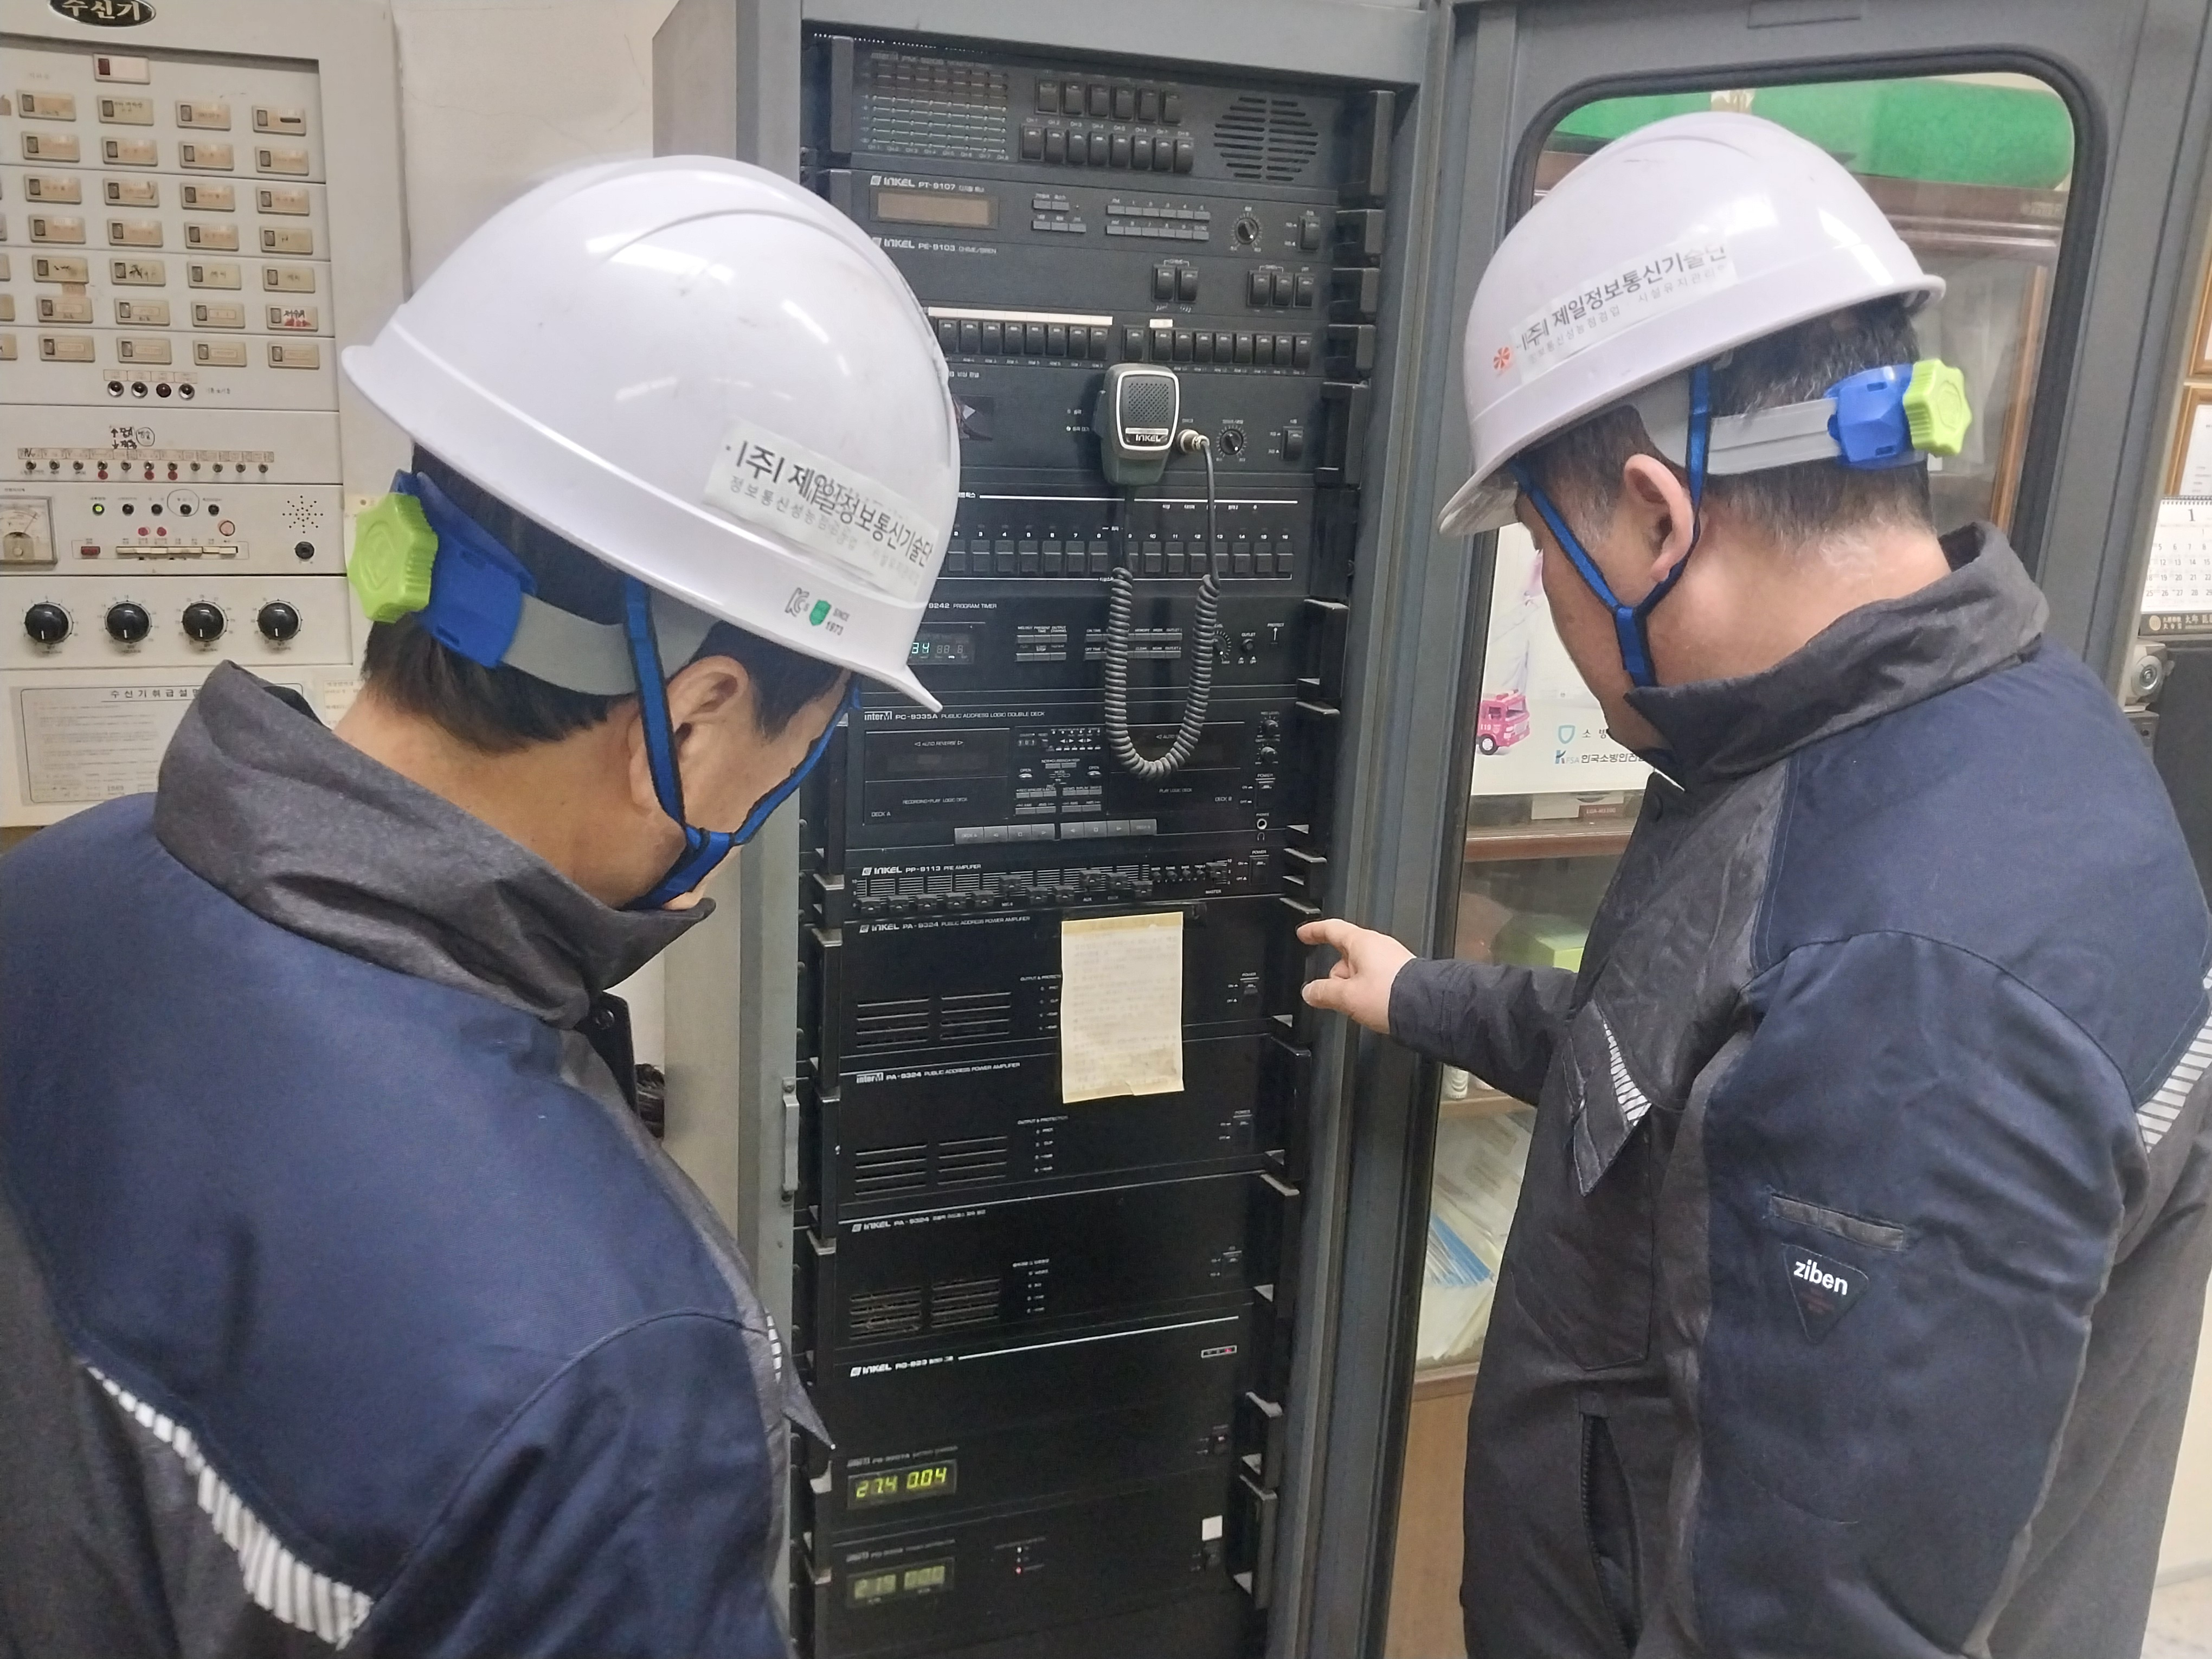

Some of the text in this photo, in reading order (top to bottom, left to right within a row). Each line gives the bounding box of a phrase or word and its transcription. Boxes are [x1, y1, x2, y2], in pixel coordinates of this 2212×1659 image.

[62, 0, 140, 21] 수신기
[884, 177, 915, 188] INKEL
[884, 239, 915, 249] INKEL
[2188, 509, 2195, 522] 1
[825, 620, 844, 635] 1973
[864, 1220, 891, 1230] INKEL
[1793, 1259, 1848, 1295] ziben
[863, 1364, 892, 1374] INKEL
